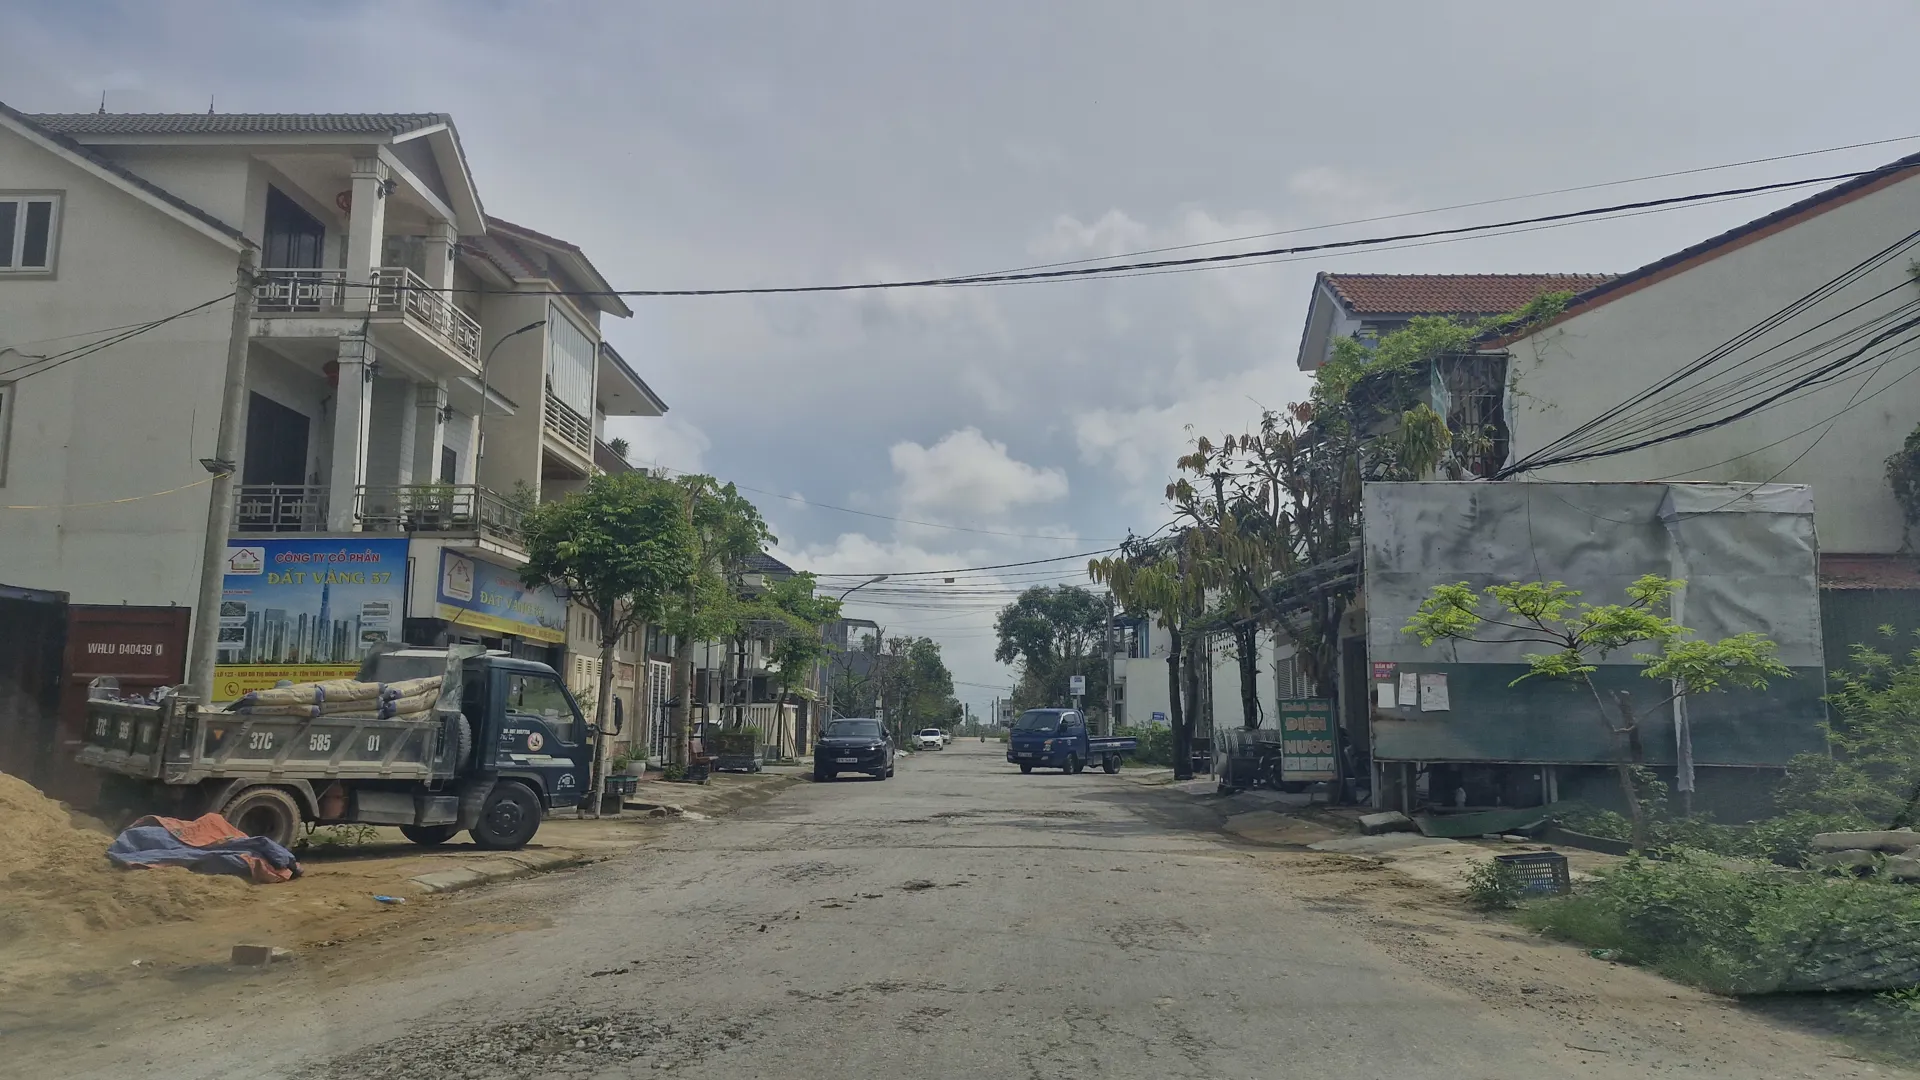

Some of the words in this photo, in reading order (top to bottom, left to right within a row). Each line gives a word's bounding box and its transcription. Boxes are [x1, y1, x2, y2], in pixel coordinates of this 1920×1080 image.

[275, 550, 310, 563] CÔNG
[313, 552, 325, 563] TY
[328, 548, 347, 563] CỔ
[349, 548, 380, 563] PHẦN
[267, 567, 307, 585] ĐẤT
[312, 568, 365, 585] VÀNG
[370, 572, 392, 585] 37
[480, 590, 503, 607] ĐẤT
[506, 597, 534, 616] VÀNG
[87, 643, 115, 654] WHLU
[119, 643, 152, 655] 040439
[1285, 714, 1327, 734] ĐIỆN
[250, 732, 273, 750] 37C
[309, 734, 332, 751] 585
[367, 735, 380, 751] 01
[1284, 737, 1332, 754] NƯỚC
